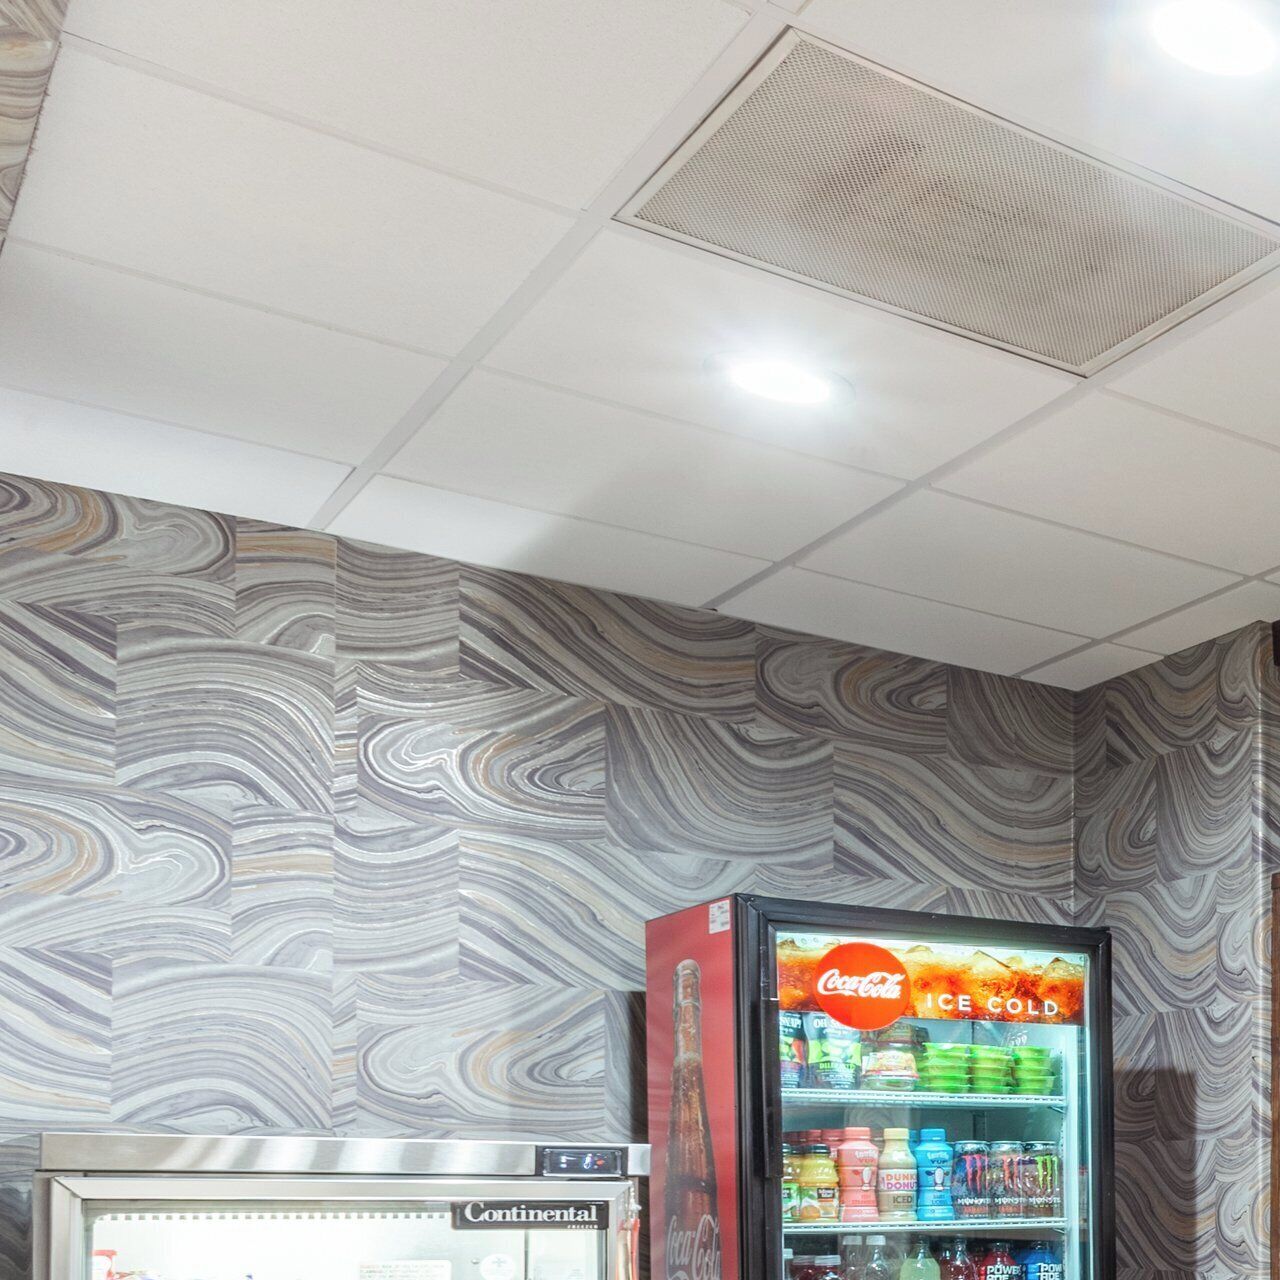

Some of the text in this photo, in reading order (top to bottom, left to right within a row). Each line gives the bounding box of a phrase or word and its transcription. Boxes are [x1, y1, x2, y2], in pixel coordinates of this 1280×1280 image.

[817, 968, 906, 999] Coca-Cola
[926, 993, 1059, 1016] ICE COLD
[892, 1196, 912, 1204] ICED
[465, 1201, 597, 1222] Continental
